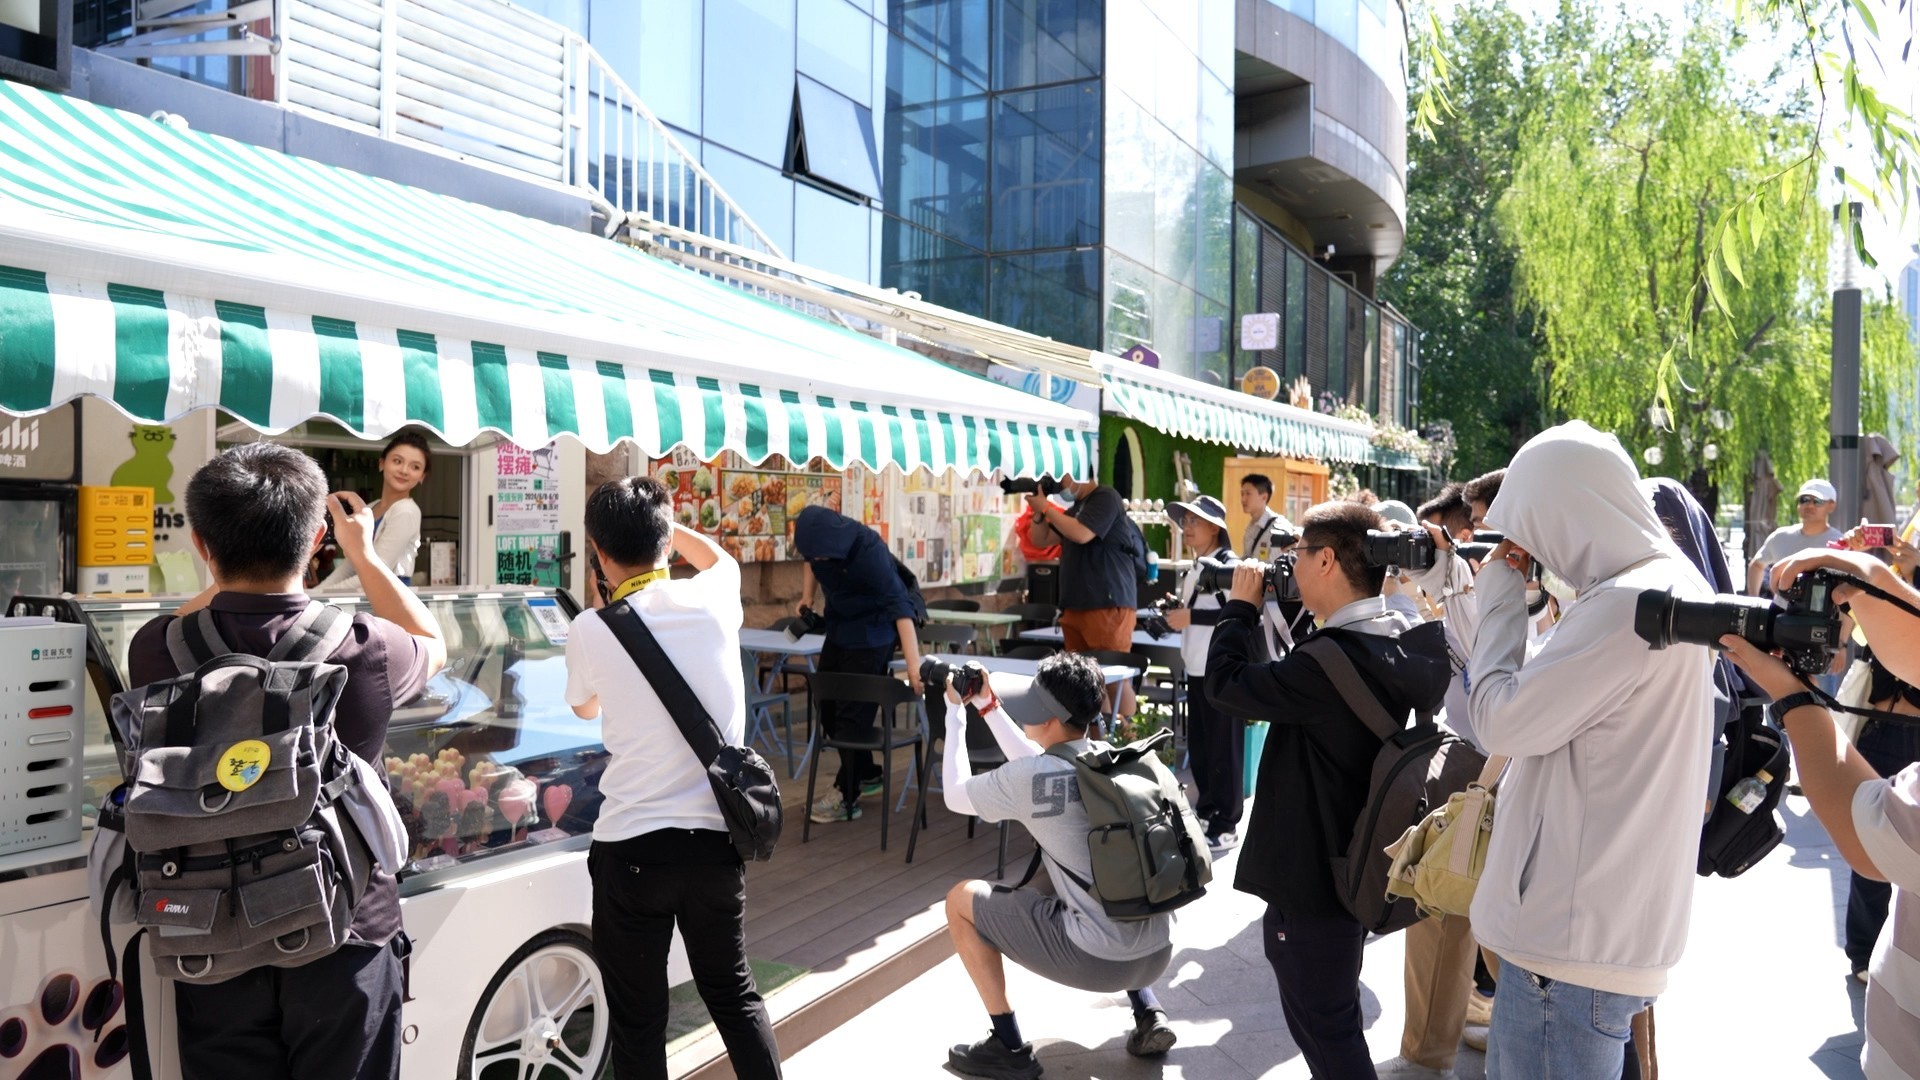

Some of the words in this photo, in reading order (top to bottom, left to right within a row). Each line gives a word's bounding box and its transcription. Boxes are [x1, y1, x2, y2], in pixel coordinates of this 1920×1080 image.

[497, 536, 517, 550] LOFT
[497, 550, 532, 572] 随机
[631, 578, 651, 588] Nikon
